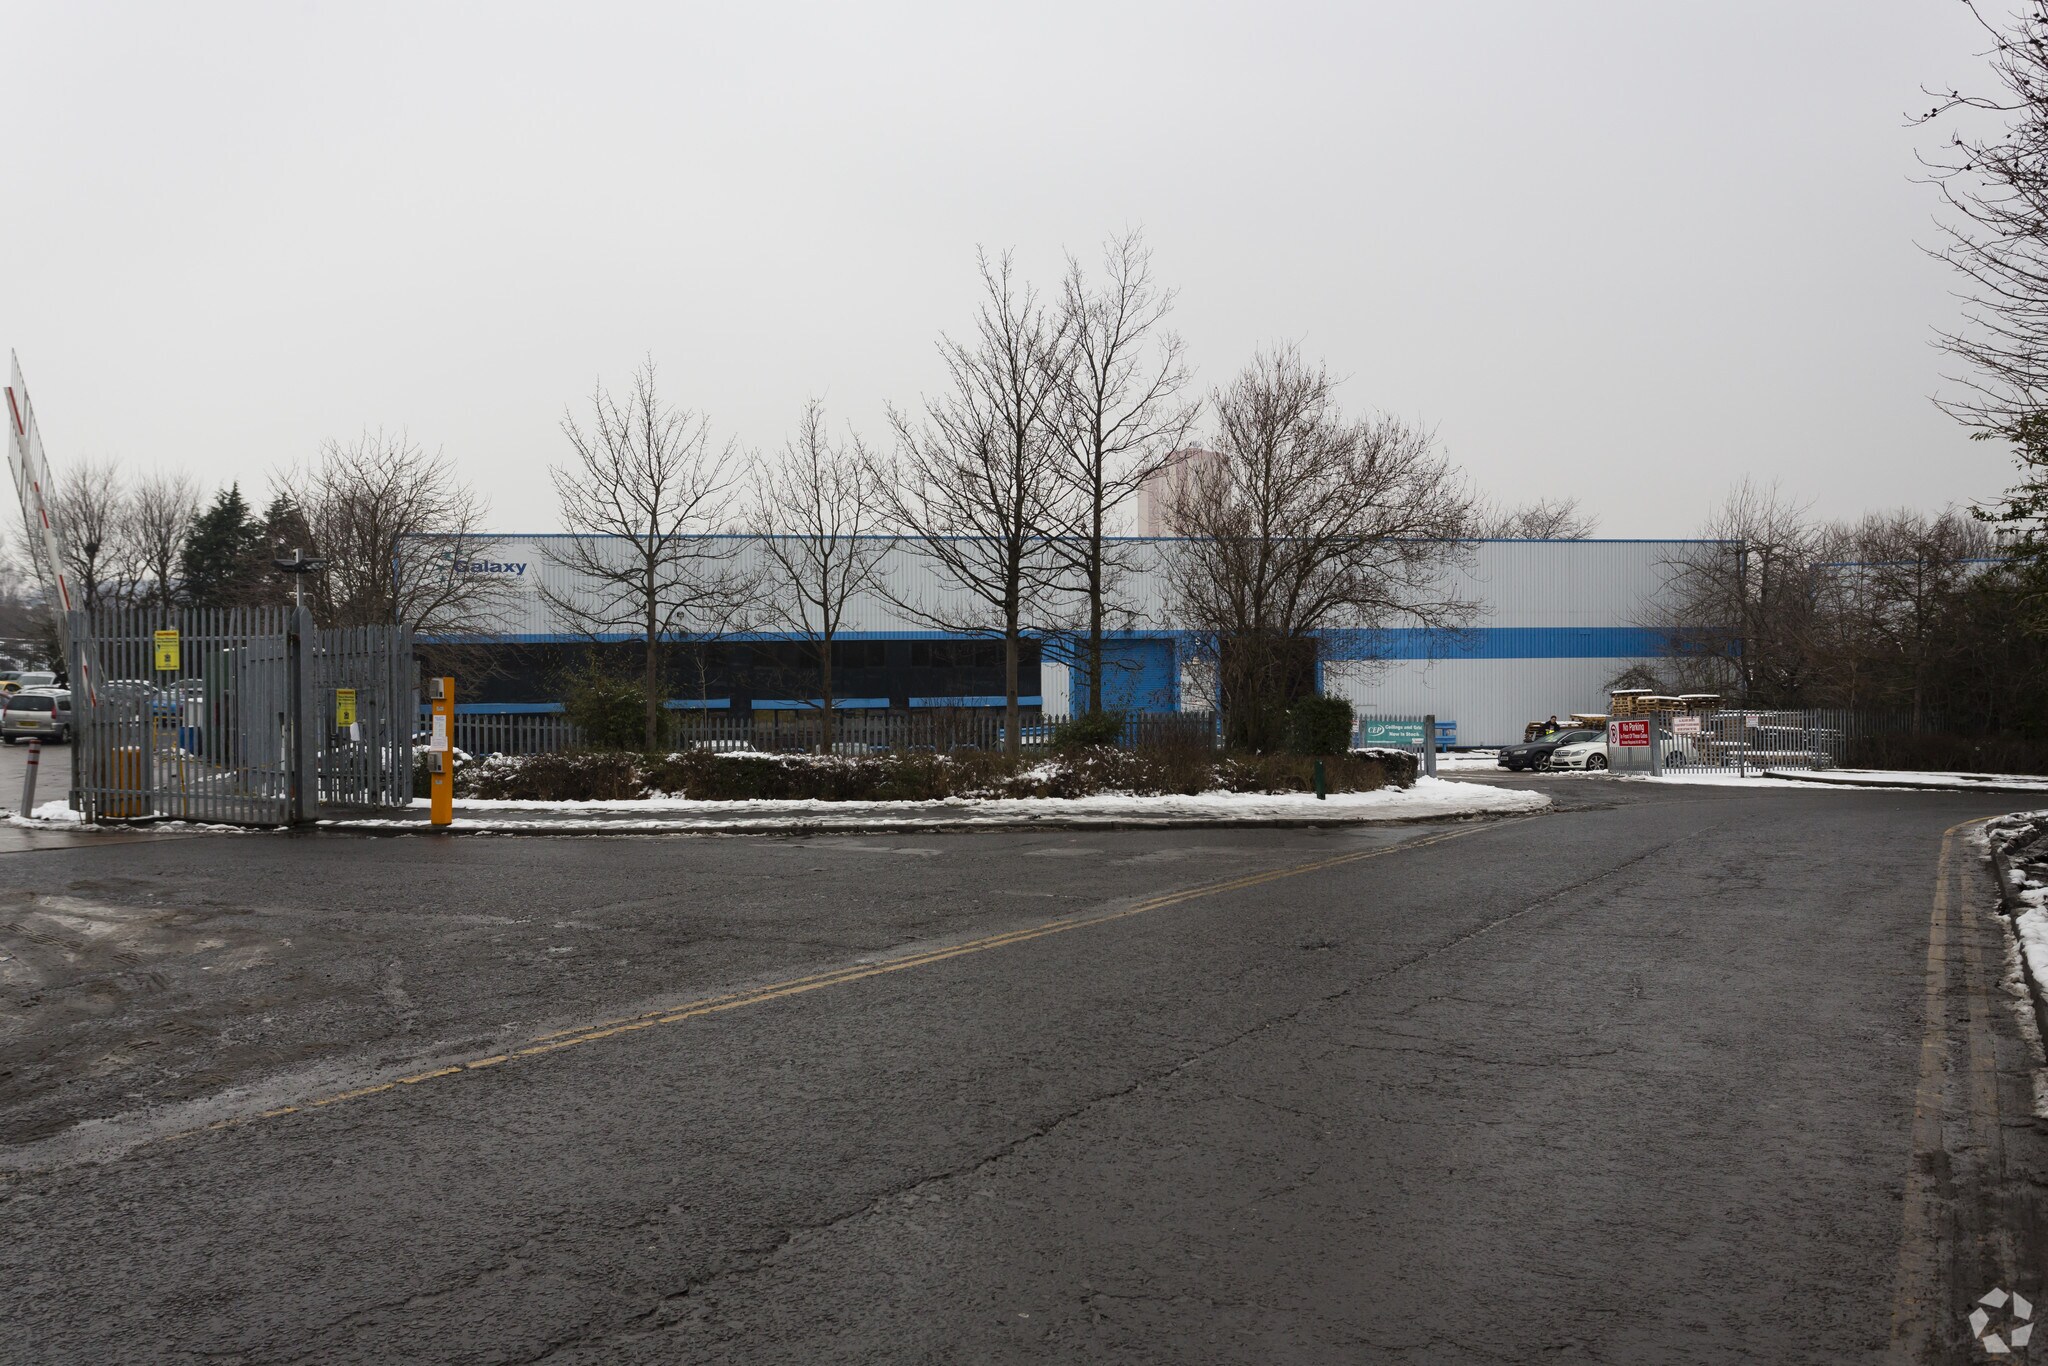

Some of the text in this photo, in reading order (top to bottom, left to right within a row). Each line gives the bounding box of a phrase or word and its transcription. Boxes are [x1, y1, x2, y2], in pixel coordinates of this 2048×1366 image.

[454, 560, 527, 575] Galaxy
[1368, 726, 1382, 734] CEP
[1629, 723, 1644, 733] Parking
